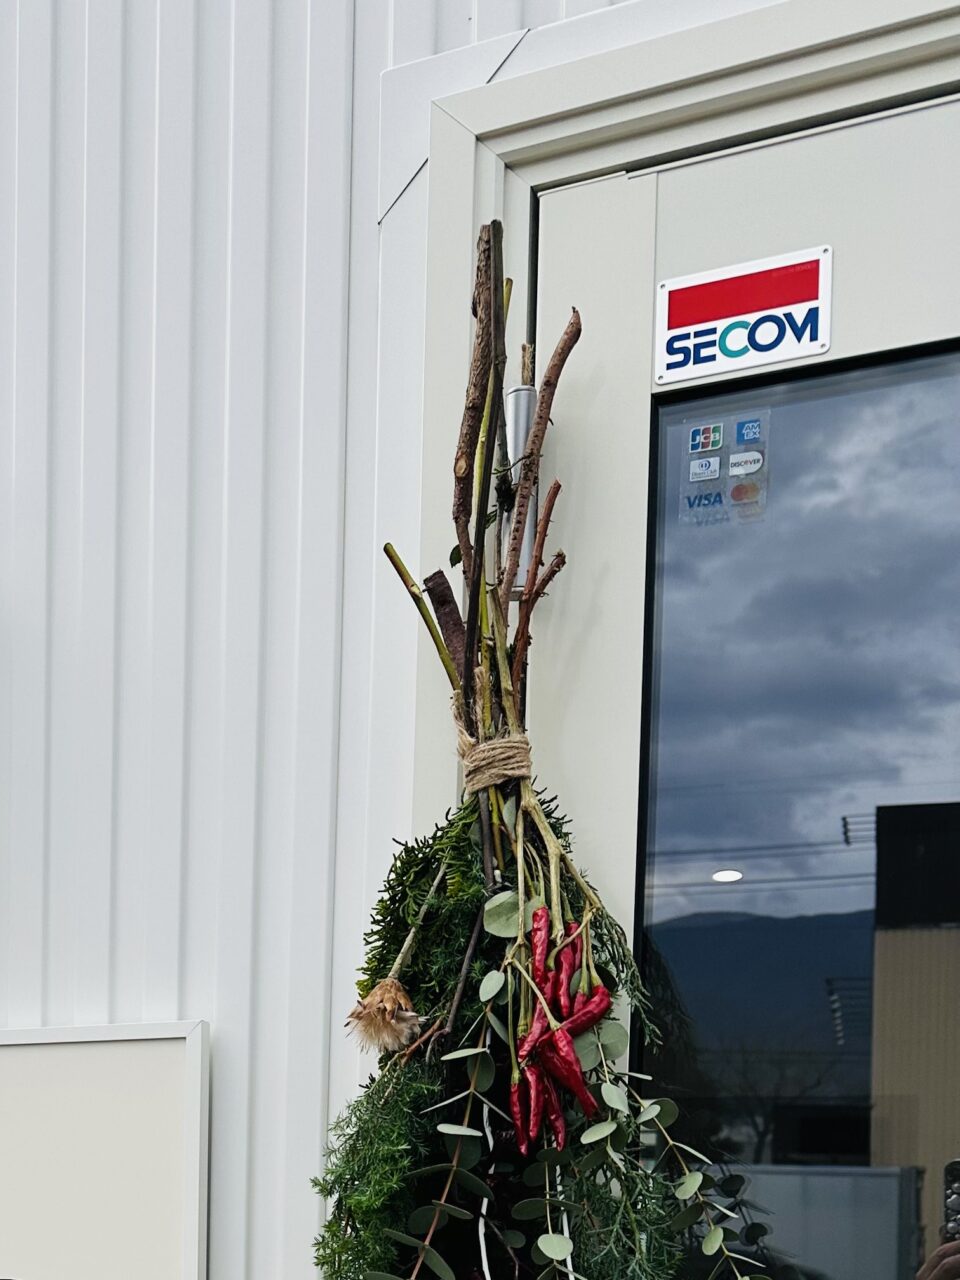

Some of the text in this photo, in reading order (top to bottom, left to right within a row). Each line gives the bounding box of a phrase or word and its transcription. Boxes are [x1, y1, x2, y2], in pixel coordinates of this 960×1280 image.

[666, 306, 819, 371] SECOM
[730, 459, 762, 469] DISCOVER
[687, 491, 723, 509] VISA
